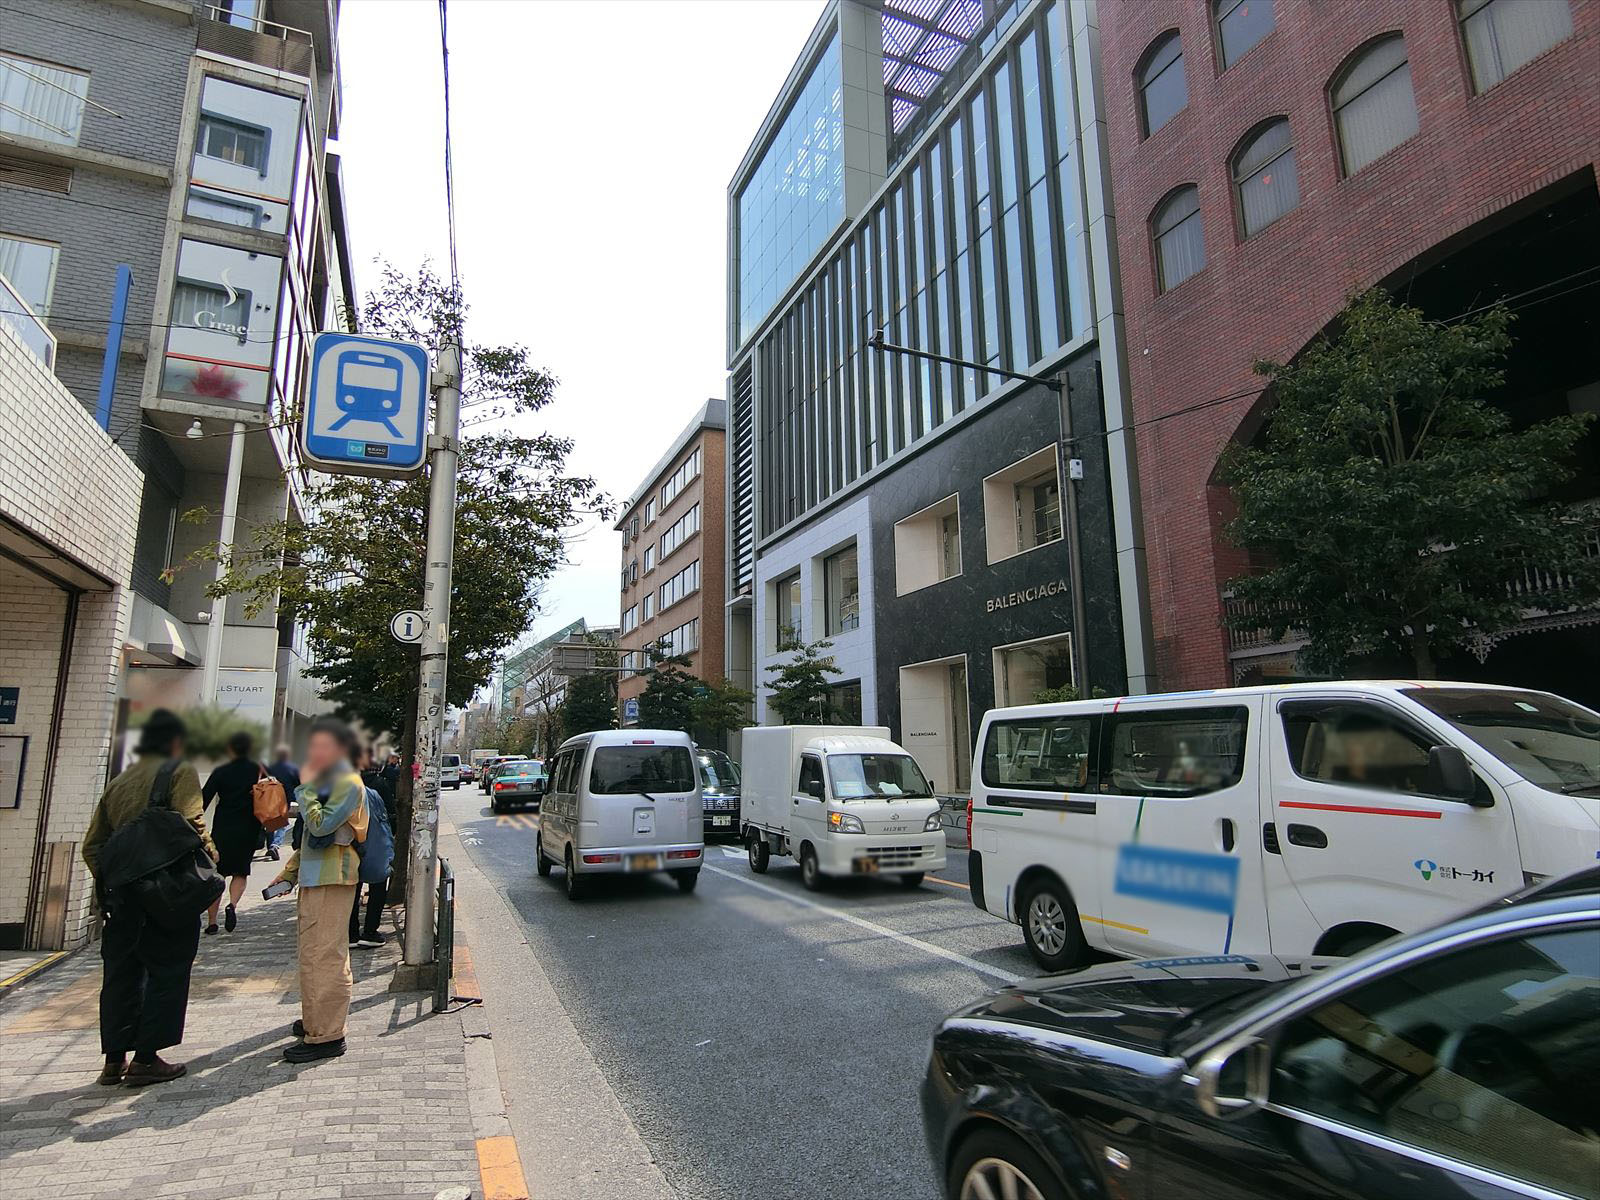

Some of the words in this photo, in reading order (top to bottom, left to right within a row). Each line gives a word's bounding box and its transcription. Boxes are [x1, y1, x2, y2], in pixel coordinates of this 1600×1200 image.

[986, 579, 1068, 613] BALENCIAGA
[1452, 867, 1495, 883] トーカイ
